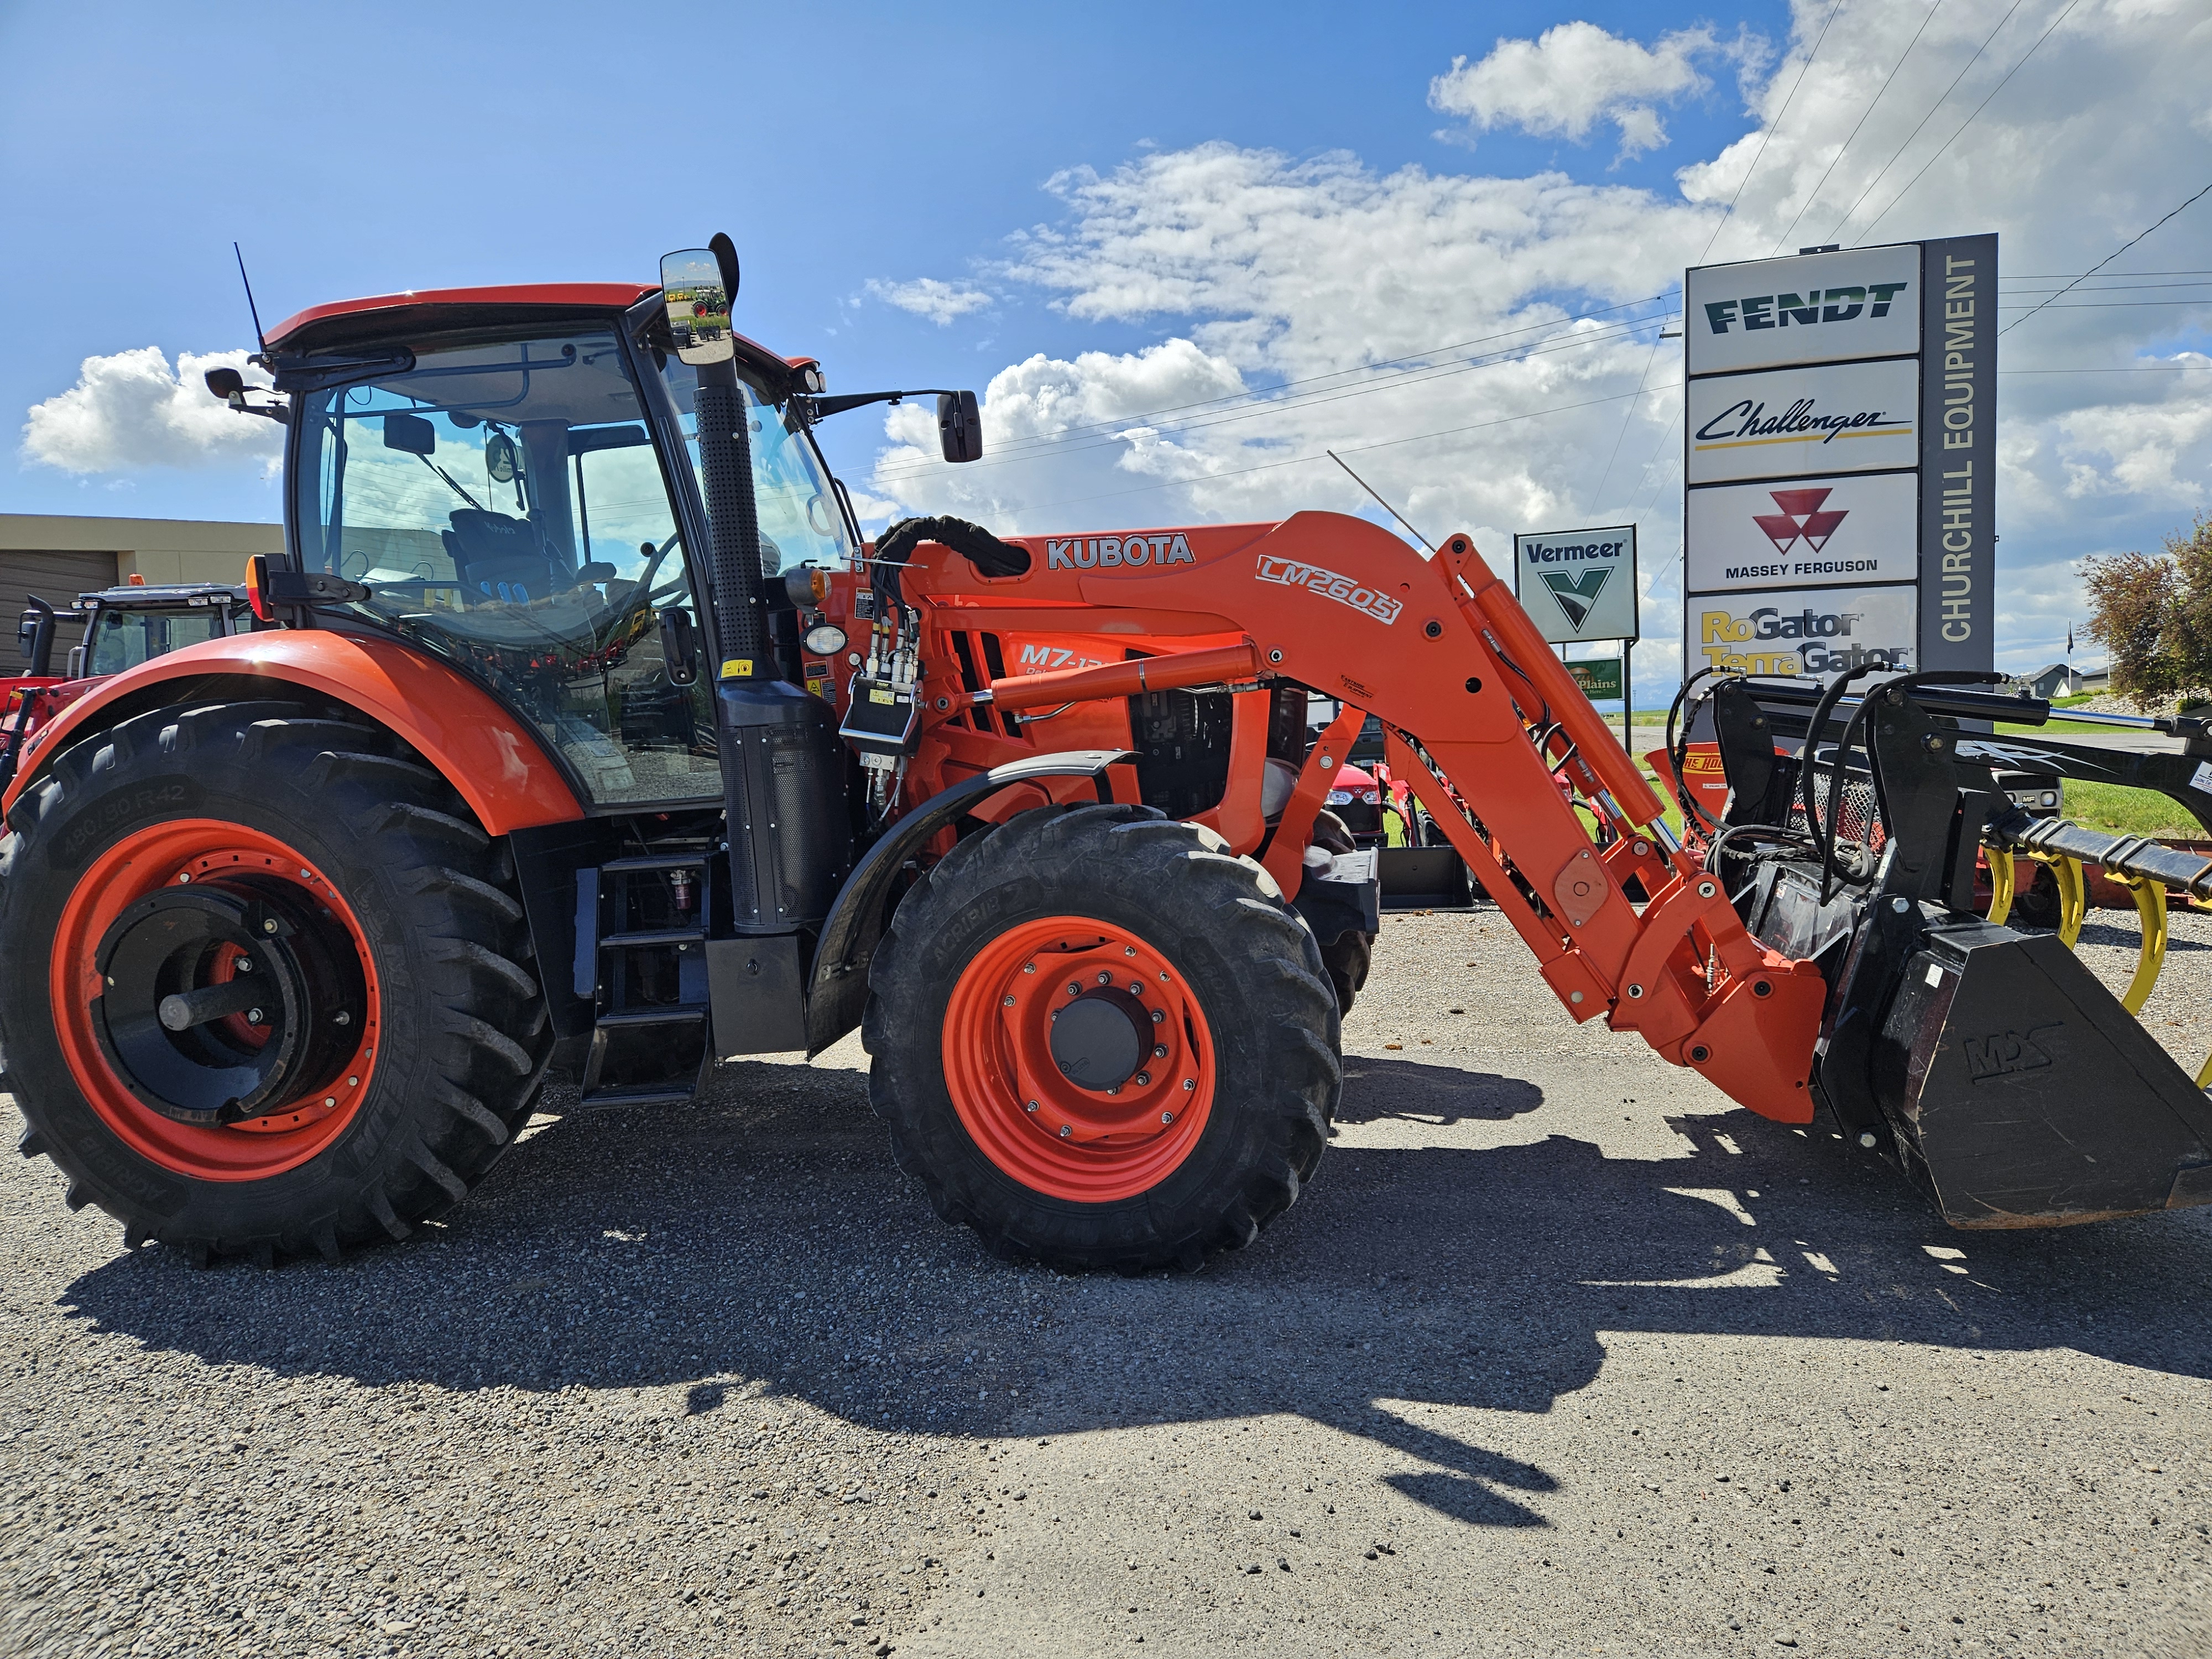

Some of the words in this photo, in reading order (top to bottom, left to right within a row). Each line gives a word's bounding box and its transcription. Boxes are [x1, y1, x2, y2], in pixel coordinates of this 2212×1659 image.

[1704, 281, 1908, 335] FENDT
[1944, 255, 1975, 450] EQUIPMENT
[1695, 398, 1912, 444] Challenger
[1047, 534, 1194, 570] KUBOTA
[1526, 541, 1624, 564] Vermeer
[1726, 564, 1788, 579] MASSEY
[1794, 559, 1878, 574] FERGUSON
[1942, 460, 1973, 642] CHURCHILL
[1260, 560, 1397, 613] LM2605
[1702, 608, 1860, 644] RoGator
[1702, 641, 1908, 677] TerraGator
[1578, 679, 1617, 690] Plains
[933, 895, 1002, 968] AGRIBIB
